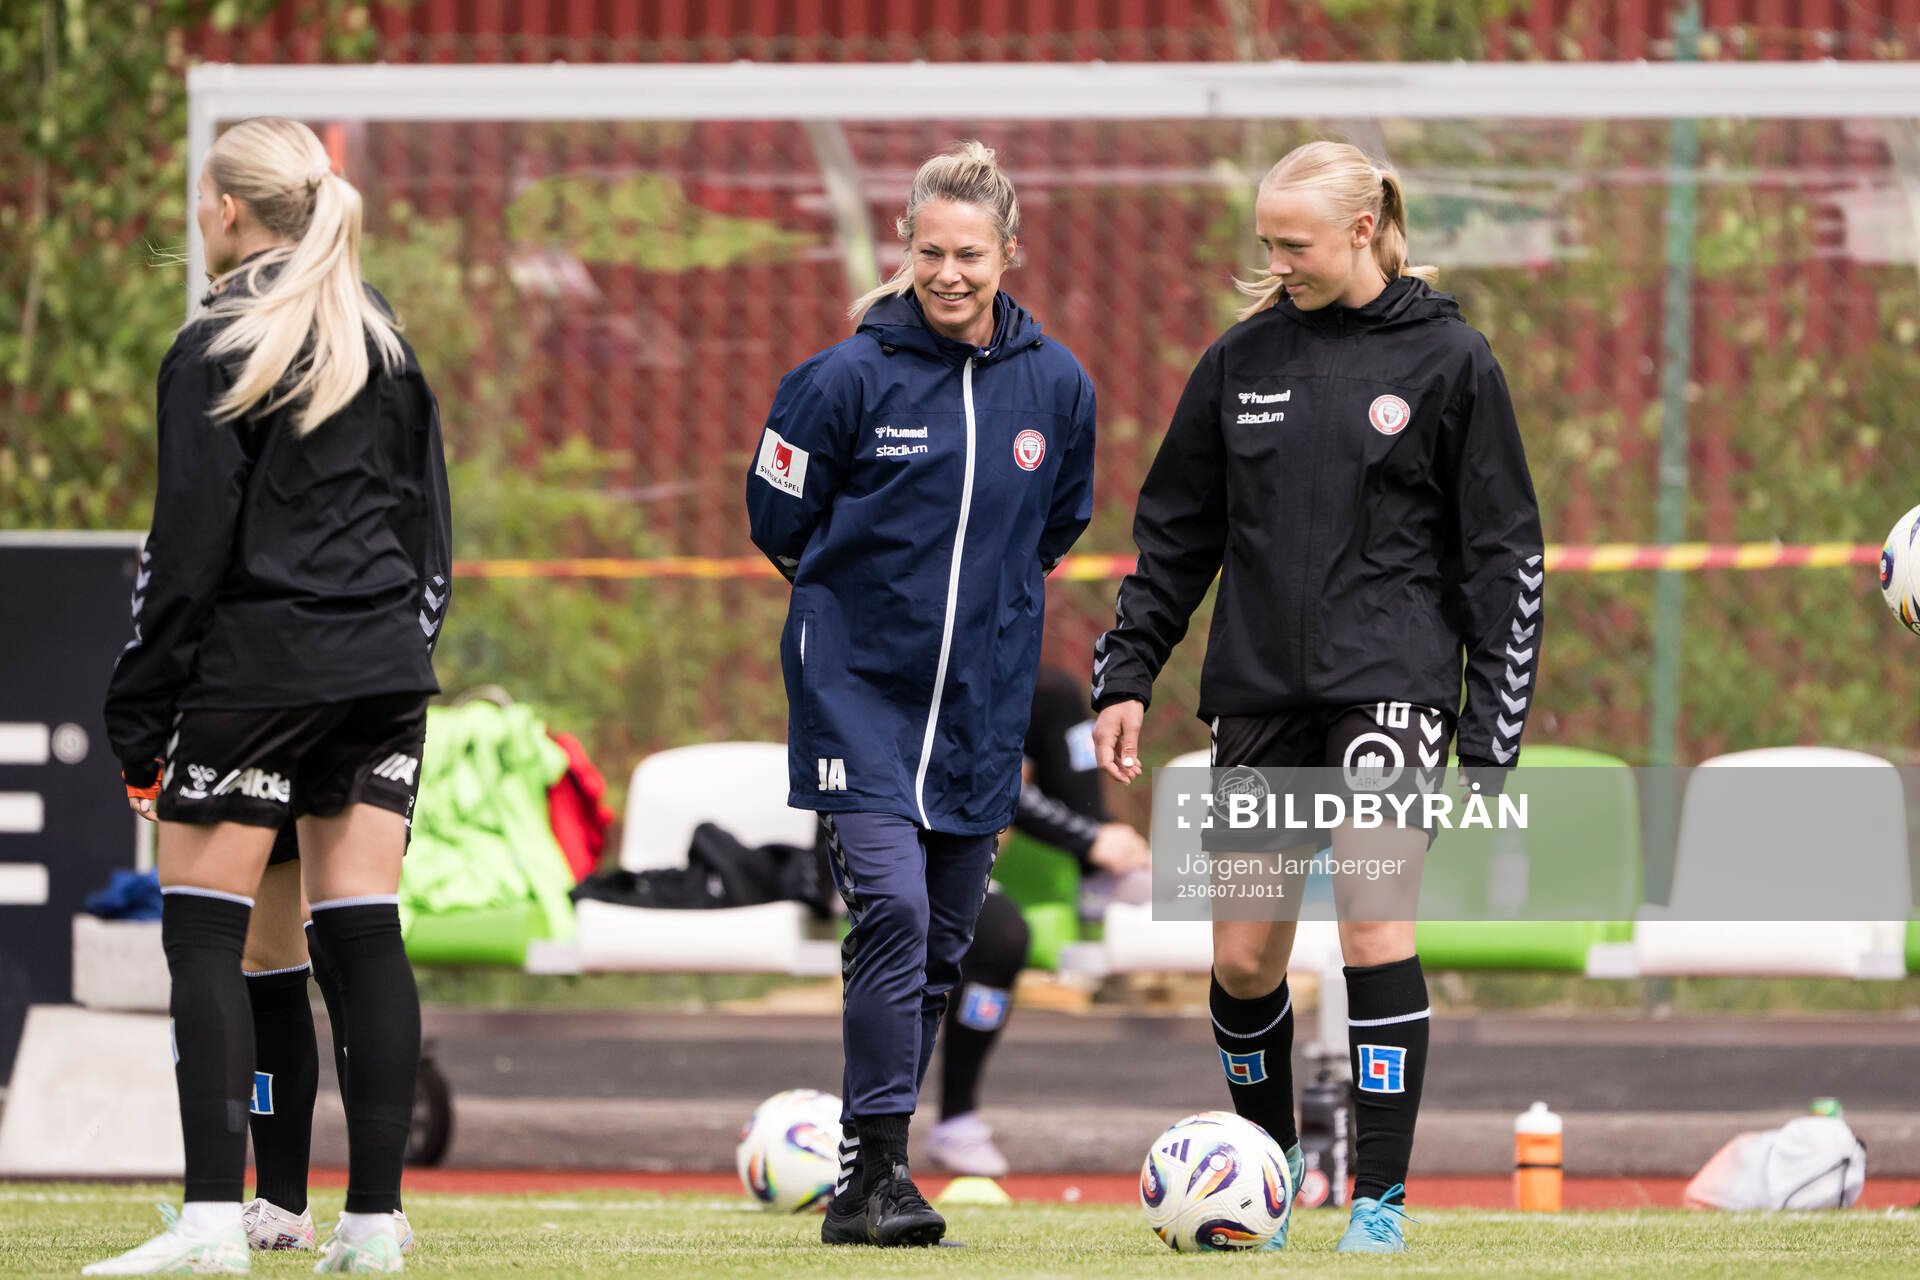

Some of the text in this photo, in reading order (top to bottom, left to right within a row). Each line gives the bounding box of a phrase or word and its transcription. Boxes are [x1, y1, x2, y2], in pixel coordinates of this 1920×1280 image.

[1237, 411, 1284, 424] stadium
[886, 426, 928, 439] hummel
[876, 444, 928, 457] stadium
[784, 481, 800, 494] SPEL
[1376, 701, 1411, 729] 10
[818, 758, 847, 790] JA
[1356, 777, 1379, 788] ABK
